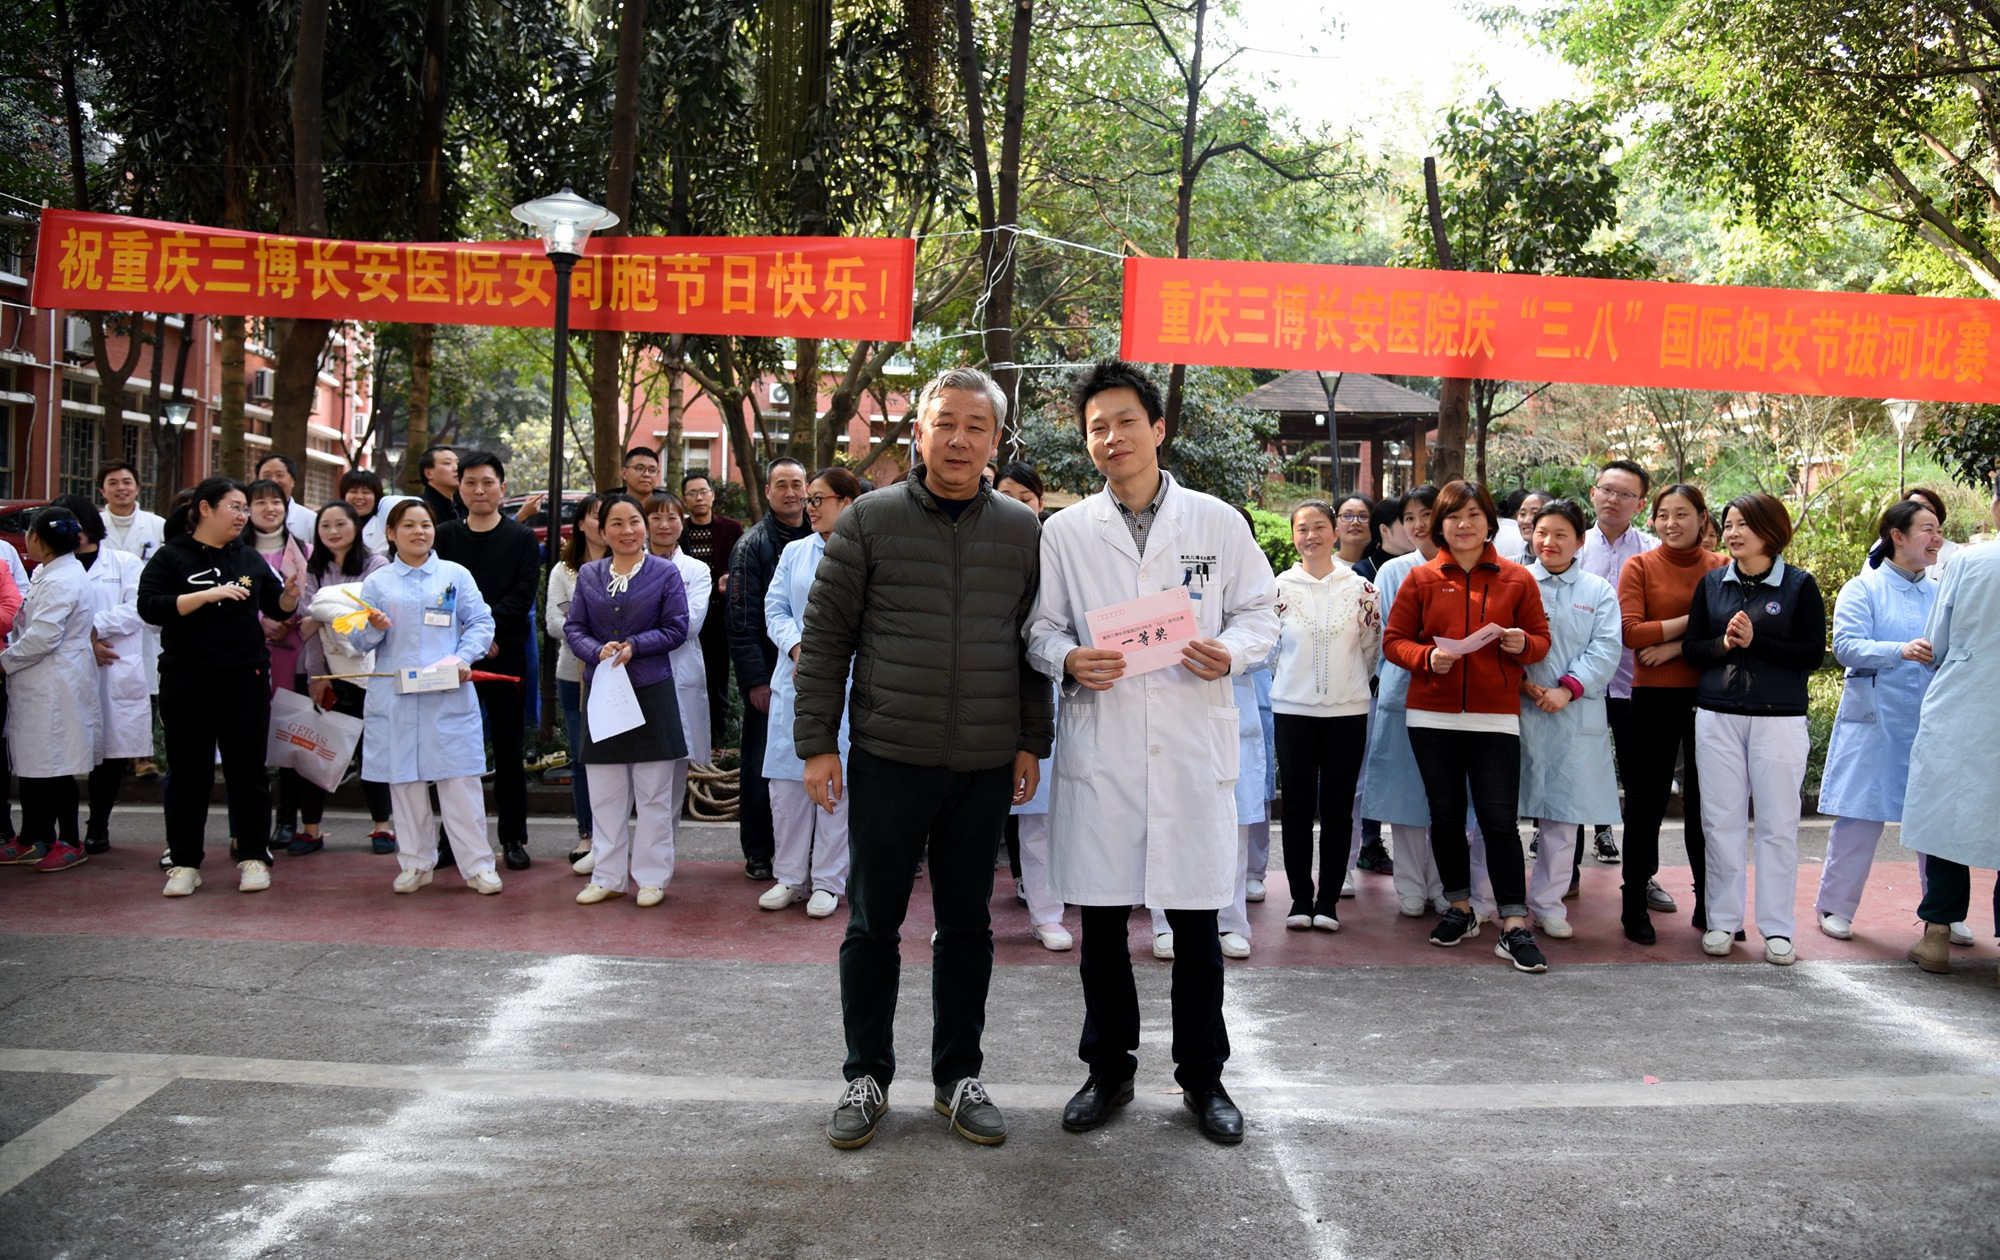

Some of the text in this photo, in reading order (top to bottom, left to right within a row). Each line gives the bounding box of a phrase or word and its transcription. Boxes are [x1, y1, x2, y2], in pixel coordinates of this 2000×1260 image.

[1121, 626, 1168, 646] 一等奖
[287, 722, 329, 747] GERAS
